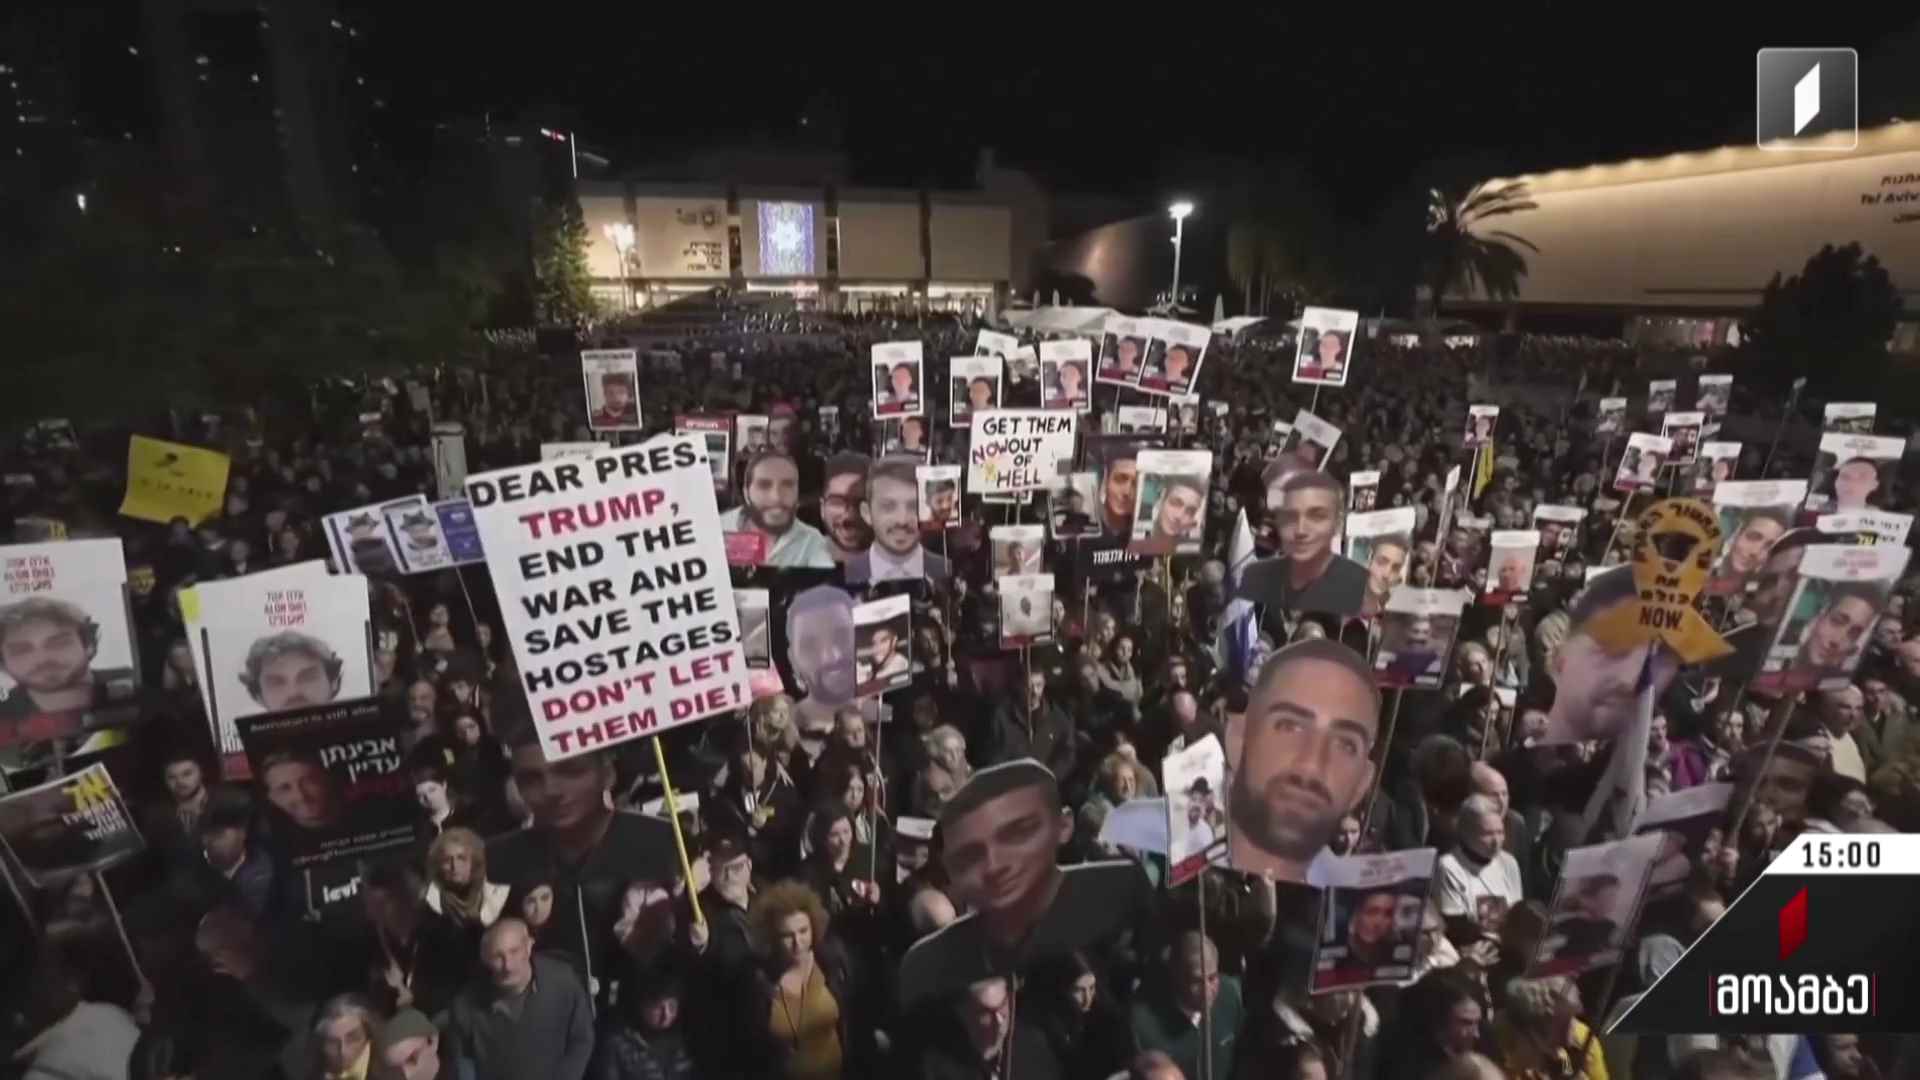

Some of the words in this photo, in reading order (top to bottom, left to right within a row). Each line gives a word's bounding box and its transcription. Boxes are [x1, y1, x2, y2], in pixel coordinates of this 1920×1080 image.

[972, 438, 1008, 464] NOW
[983, 416, 1022, 435] GET
[1027, 416, 1071, 433] THEM
[1008, 438, 1043, 454] OUT
[468, 463, 582, 508] DEAR
[595, 441, 708, 484] PRES.
[996, 467, 1041, 488] HELL
[1013, 454, 1033, 467] OF
[518, 488, 680, 539] TRUMP,
[518, 540, 604, 580] END
[616, 520, 696, 558] THE
[521, 579, 616, 620] WAR
[629, 557, 707, 596] AND
[524, 608, 631, 656] SAVE
[641, 588, 718, 625] THE
[524, 620, 742, 693] HOSTAGES.
[542, 672, 656, 722] DON'T
[670, 651, 735, 687] LET
[550, 708, 657, 754] THEM
[671, 683, 742, 721] DIE!
[319, 736, 396, 768] אבינתן
[348, 755, 400, 783] עדיין
